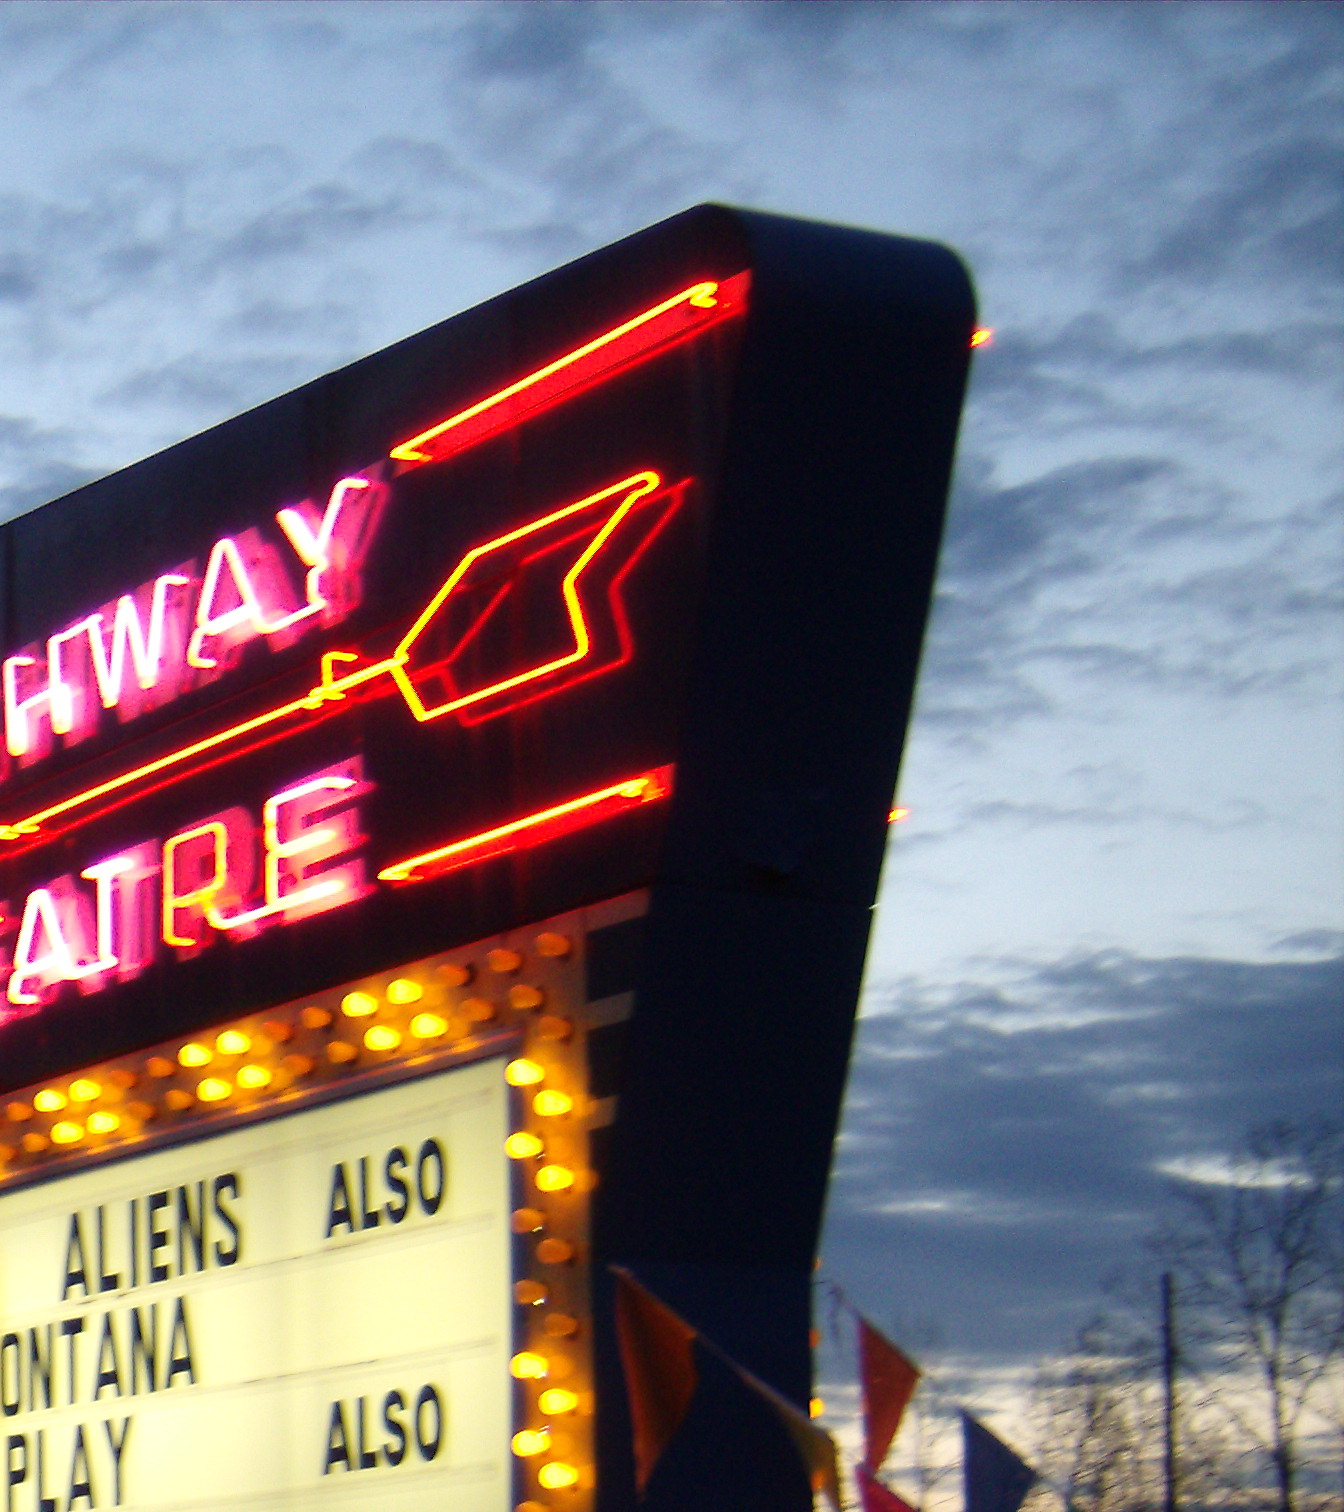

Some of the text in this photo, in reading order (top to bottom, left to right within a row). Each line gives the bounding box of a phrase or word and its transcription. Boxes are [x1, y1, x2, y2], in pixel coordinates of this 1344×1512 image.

[61, 1172, 240, 1302] ALIENS
[325, 1137, 446, 1239] ALSO
[322, 1383, 445, 1476] ALSO
